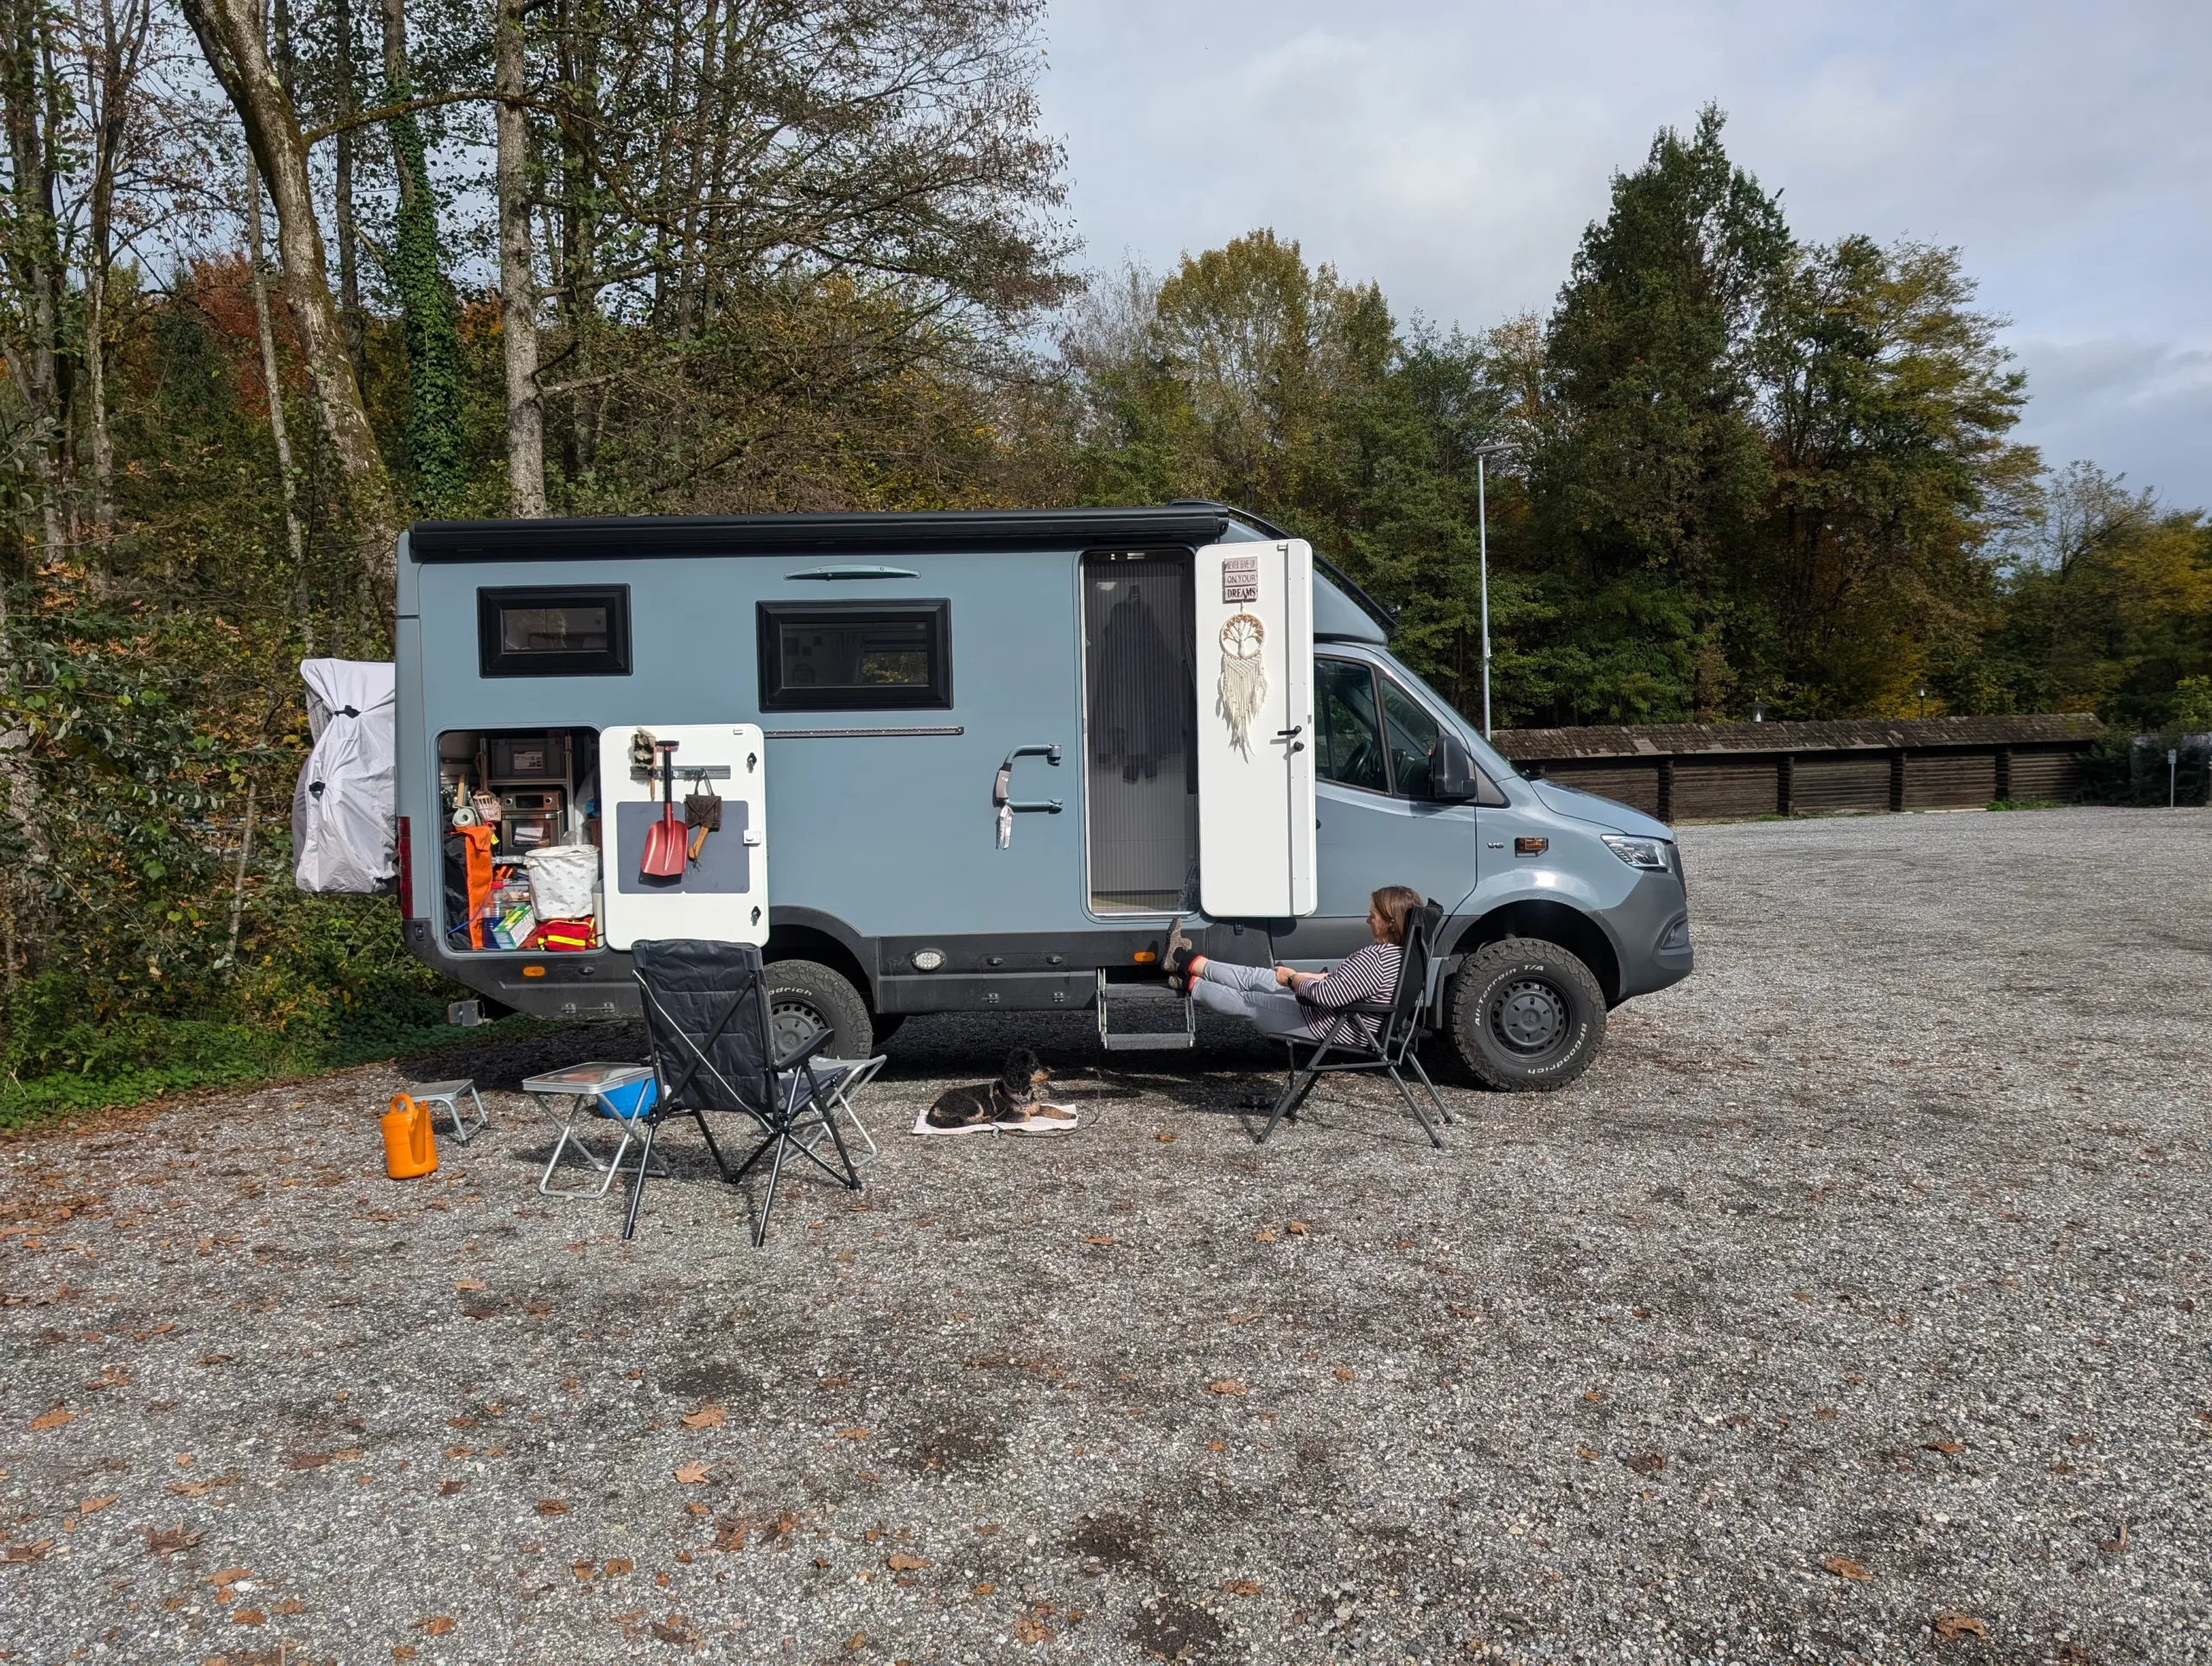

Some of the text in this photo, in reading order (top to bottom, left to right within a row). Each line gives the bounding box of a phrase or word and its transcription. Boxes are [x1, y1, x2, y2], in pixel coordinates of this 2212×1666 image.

[1227, 561, 1239, 570] NEVER
[1227, 575, 1237, 584] ON
[1227, 588, 1255, 598] DREAMS
[1474, 968, 1516, 1027] All-Terrain
[1527, 1022, 1588, 1075] BFGoodrich
